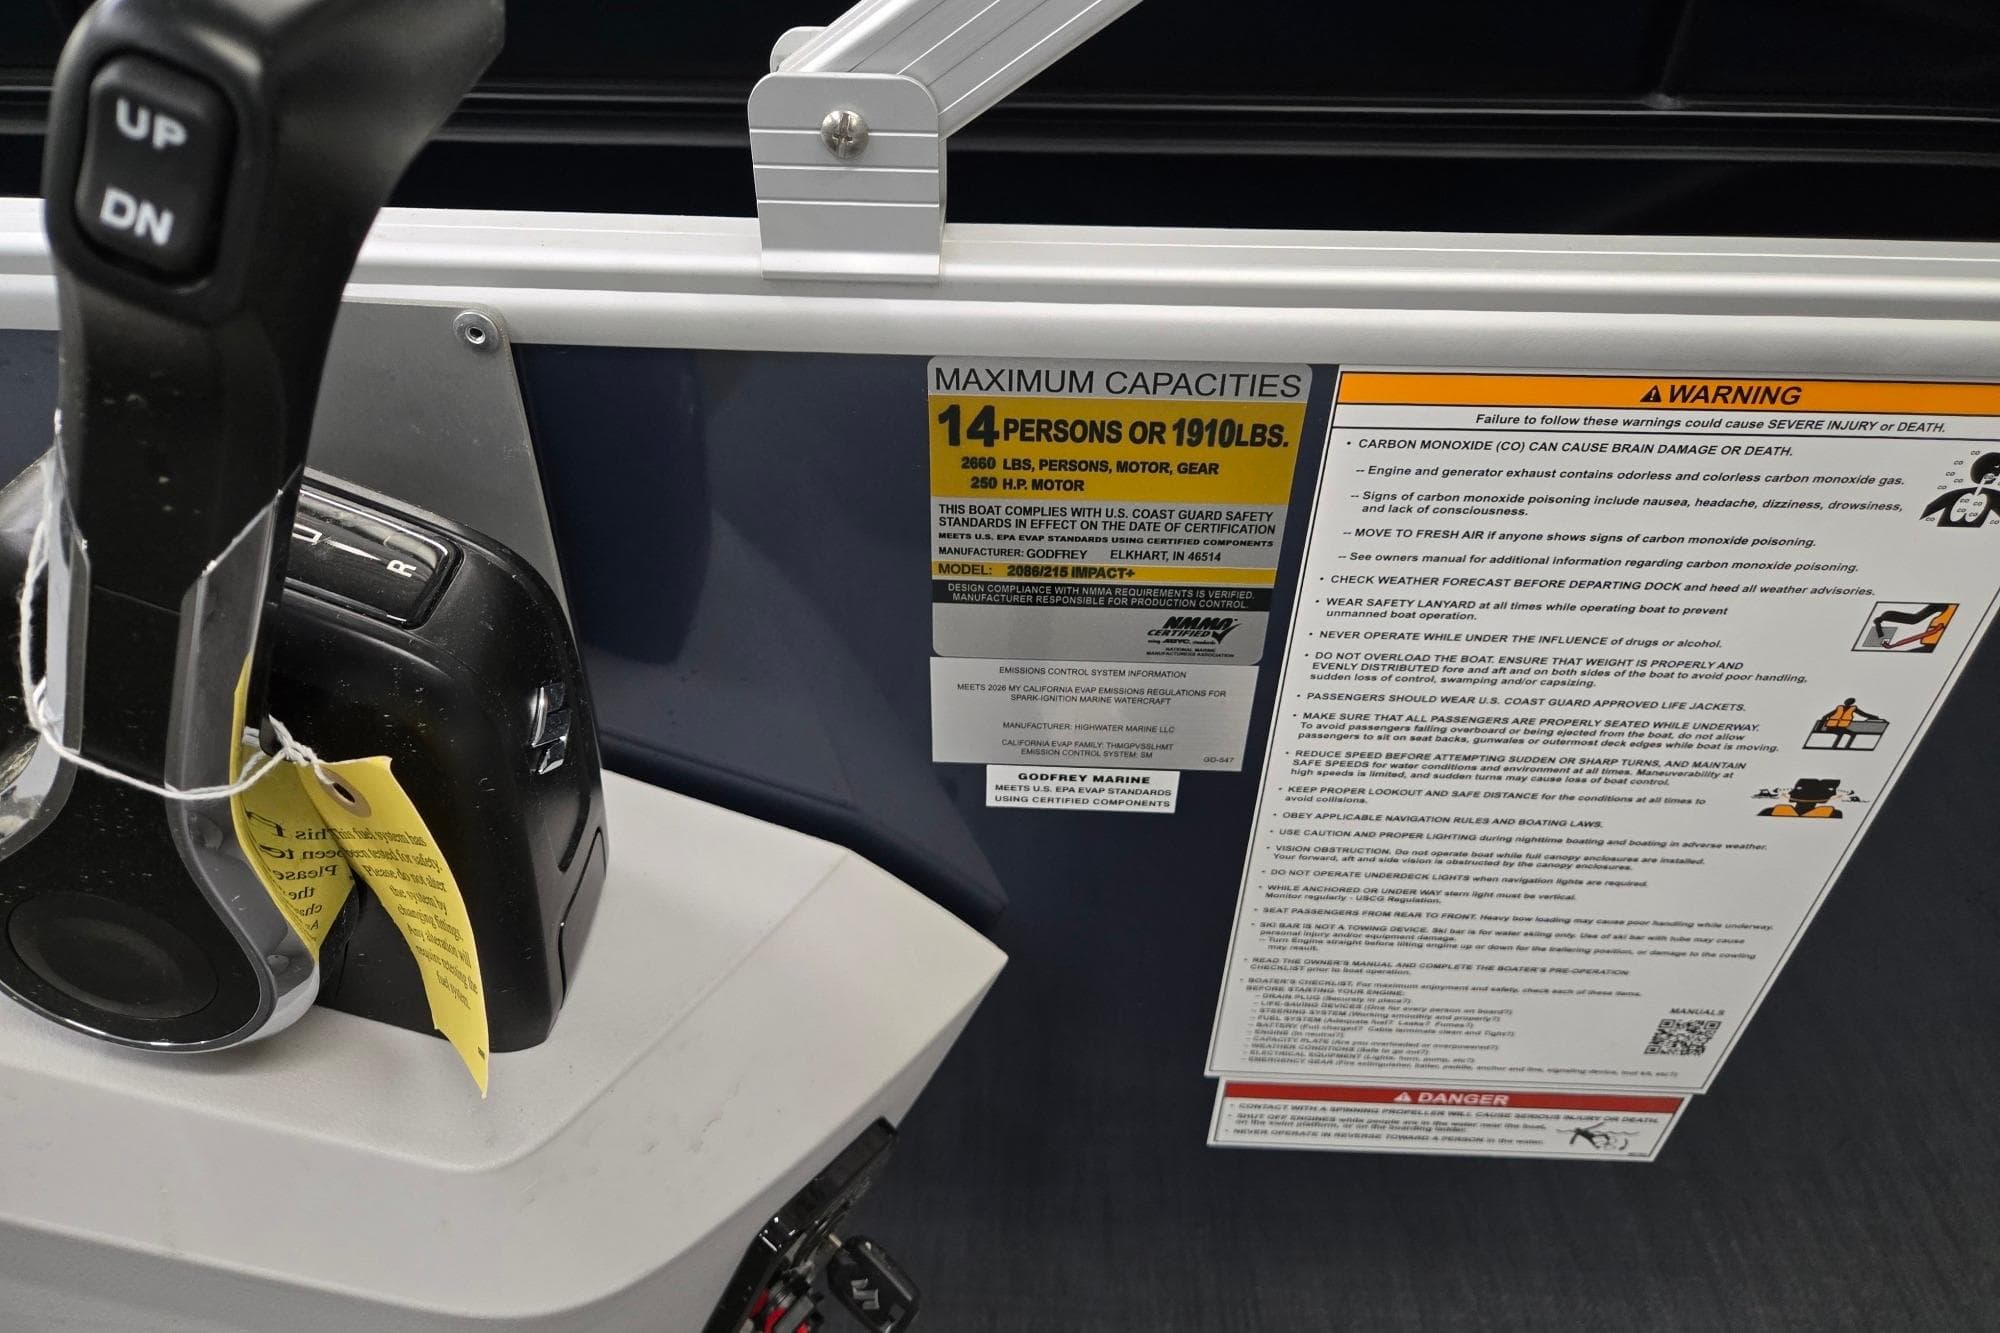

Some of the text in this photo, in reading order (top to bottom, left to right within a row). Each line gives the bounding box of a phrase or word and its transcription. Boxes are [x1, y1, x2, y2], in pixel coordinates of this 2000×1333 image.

[116, 98, 187, 149] UP
[101, 187, 174, 245] DN
[935, 367, 1301, 398] MAXIMUM CAPACITIES
[1668, 385, 1802, 405] WARNING
[938, 405, 999, 447] 14
[1004, 418, 1123, 444] PERSONS
[1128, 420, 1166, 445] OR
[1475, 414, 1520, 425] Failure
[1524, 415, 1537, 425] to
[1540, 415, 1580, 425] follow
[1583, 416, 1619, 426] these
[1622, 417, 1682, 430] warnings
[1685, 418, 1723, 428] could
[1725, 421, 1764, 429] cause
[1767, 419, 1825, 430] SEVERE
[1826, 420, 1879, 431] INJURY
[1897, 422, 1945, 432] DEATH.
[1358, 438, 1792, 456] CARBON MONOXIDE (CO) CAN CAUSE BRAIN DAMAGE OR DEATH.
[961, 456, 1220, 476] 2660 LBS, PERSONS, MOTOR, GEAR
[970, 476, 1085, 492] 250 H.P. MOTOR
[938, 504, 1274, 522] THIS BOAT COMPLIES WITH U.S. COAST GUARD SAFETY
[939, 516, 1276, 535] STANDARDS IN EFFECT ON THE DATE OF CERTIFICATION
[938, 532, 972, 540] MEETS
[1018, 534, 1045, 542] EVAP
[1047, 535, 1108, 543] STANDARDS
[1203, 539, 1274, 547] COMPONENTS
[938, 546, 1221, 562] MANUFACTURER: GODFREY ELKHART, IN 46514
[387, 559, 417, 577] R
[938, 563, 992, 576] MODEL:
[1071, 566, 1136, 579] IMPACT+
[948, 583, 1254, 601] DESIGN COMPLIANCE WITH NMMA REQUIREMENTS IS VERIFIED.
[952, 592, 1248, 609] MANUFACTURER RESPONSIBLE FOR PRODUCTION CONTROL.
[1147, 629, 1211, 637] CERTIFIED
[1319, 630, 1361, 639] NEVER
[1363, 631, 1421, 641] OPERATE
[1424, 633, 1463, 642] WHILE
[1465, 634, 1508, 643] UNDER
[1512, 634, 1536, 643] THE
[1538, 635, 1608, 645] INFLUENCE
[1610, 637, 1624, 646] of
[1625, 638, 1659, 648] drugs
[1677, 639, 1722, 648] alcohol.
[999, 666, 1187, 679] EMISSIONS CONTROL SYSTEM INFORMATION
[957, 683, 1226, 698] MEETS 2026 MY CALIFORNIA EVAP EMISSIONS REGULATIONS FOR
[1010, 694, 1172, 705] SPARK-IGNITION MARINE WATERCRAFT
[1003, 721, 1175, 734] MANUFACTURER: HIGHWATER MARINE LLC
[1001, 739, 1050, 749] CALIFORNIA
[1051, 740, 1073, 748] EVAP
[1074, 741, 1105, 750] FAMILY:
[1020, 748, 1153, 759] EMISSION CONTROL SYSTEM: SM
[1018, 773, 1150, 784] GODFREY MARINE
[995, 784, 1030, 792] MEETS
[1108, 788, 1172, 796] STANDARDS
[994, 795, 1170, 808] USING CERTIFIED COMPONENTS
[352, 827, 376, 841] fuel
[374, 830, 411, 844] system
[405, 831, 427, 847] has
[367, 848, 400, 861] tested
[396, 848, 413, 864] for
[411, 853, 443, 874] safety.
[362, 864, 398, 879] Please
[397, 867, 411, 881] do
[410, 873, 428, 887] not
[1669, 1008, 1725, 1016] MANUALS
[1417, 1092, 1510, 1106] DANGER
